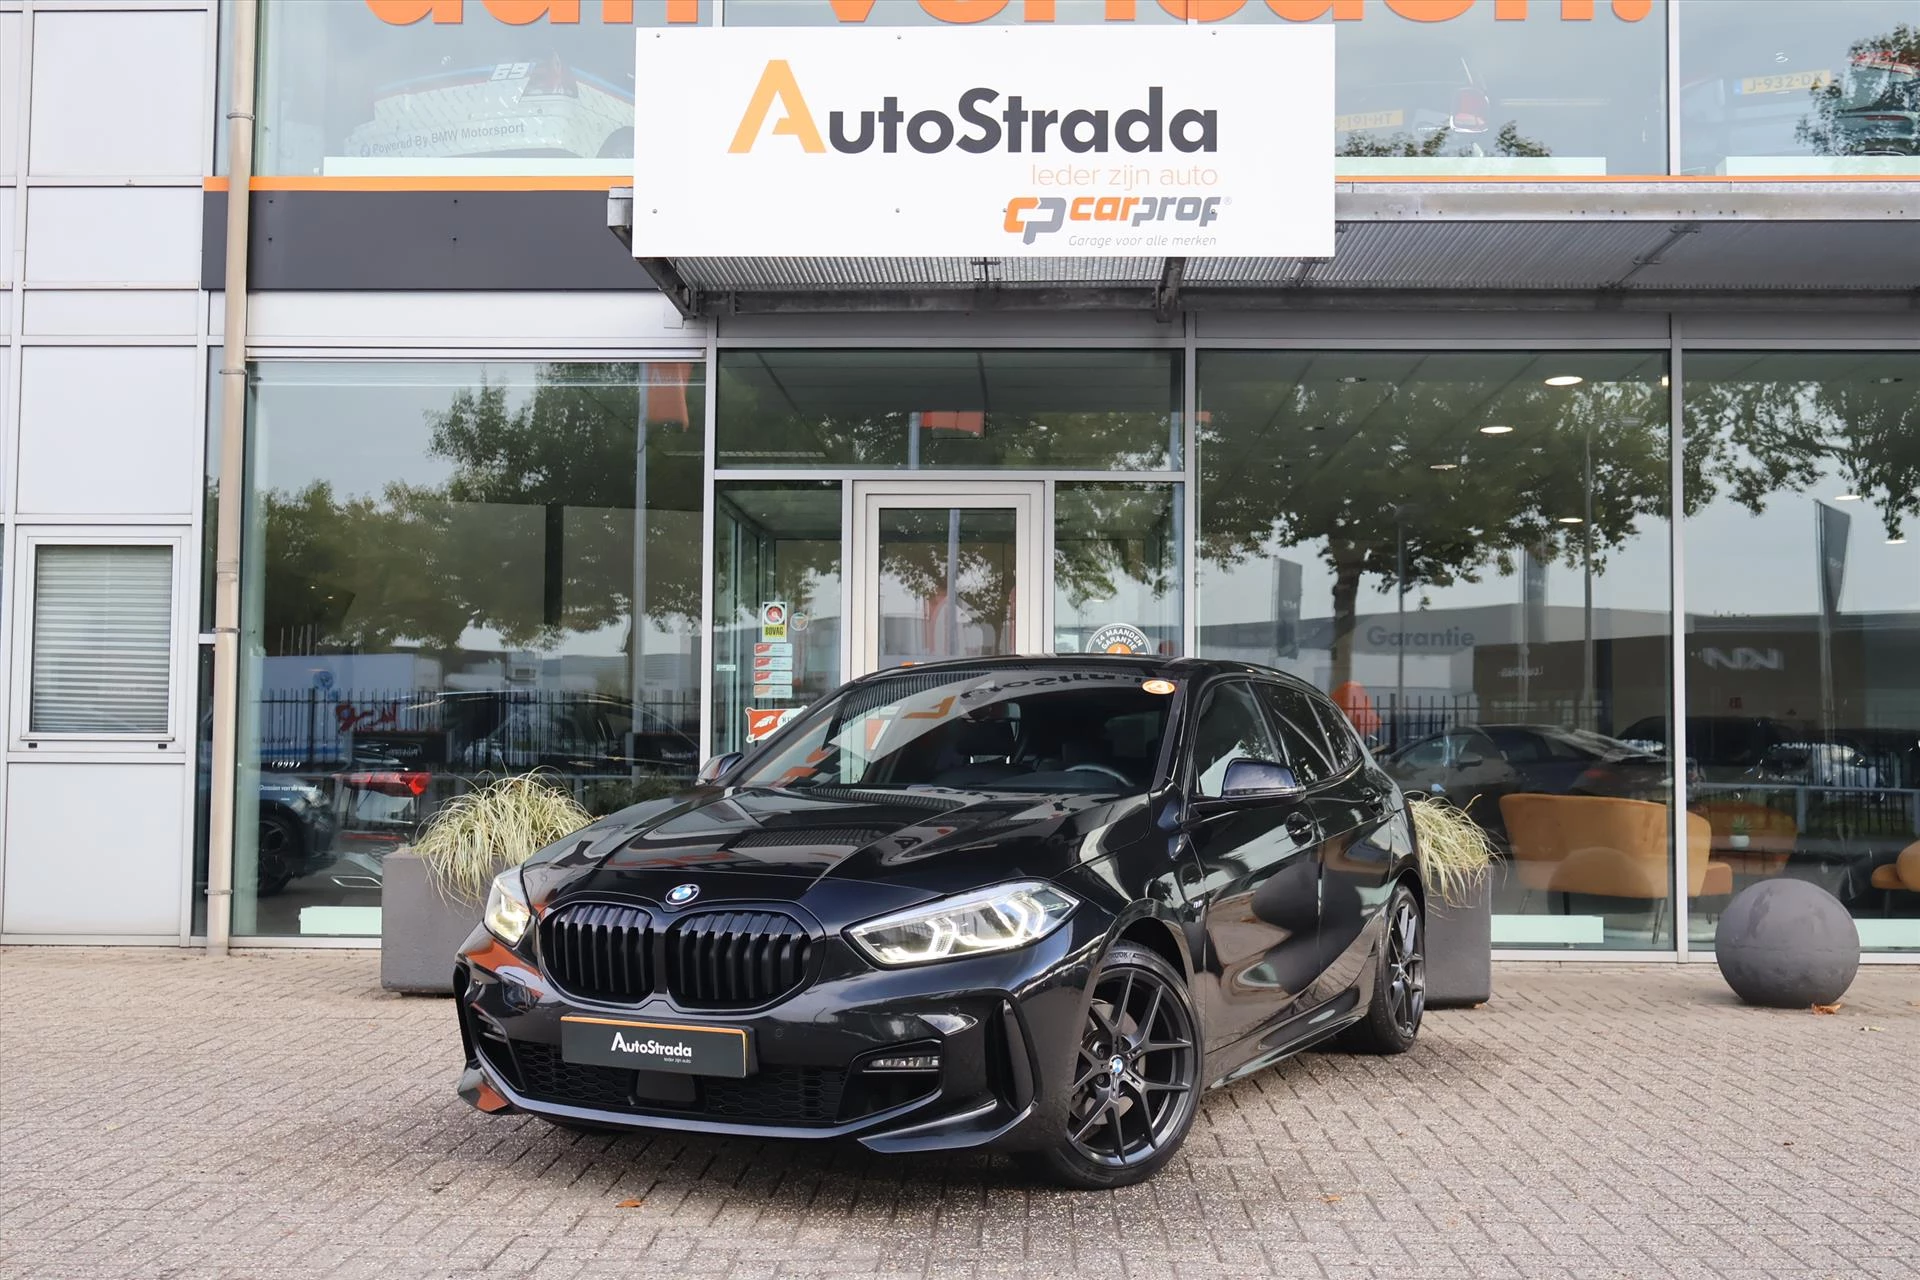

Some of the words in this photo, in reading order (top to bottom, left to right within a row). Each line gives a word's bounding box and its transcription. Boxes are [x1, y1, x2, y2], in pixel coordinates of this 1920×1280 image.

[727, 60, 1217, 154] AutoStrada
[431, 129, 458, 144] BMW
[461, 122, 525, 140] Motorsport
[1032, 164, 1101, 186] Ieder
[1108, 164, 1150, 191] zijn
[1159, 166, 1218, 186] auto
[1068, 235, 1114, 248] Garage
[1116, 237, 1143, 246] voor
[1146, 235, 1168, 246] alle
[1171, 235, 1217, 246] merken
[765, 626, 784, 636] BOVAG
[1095, 634, 1106, 645] 24
[1105, 628, 1144, 647] MAANDEN
[1366, 625, 1475, 646] Garantie
[1101, 636, 1138, 651] GARANTIE
[611, 1031, 692, 1057] AutoStrada
